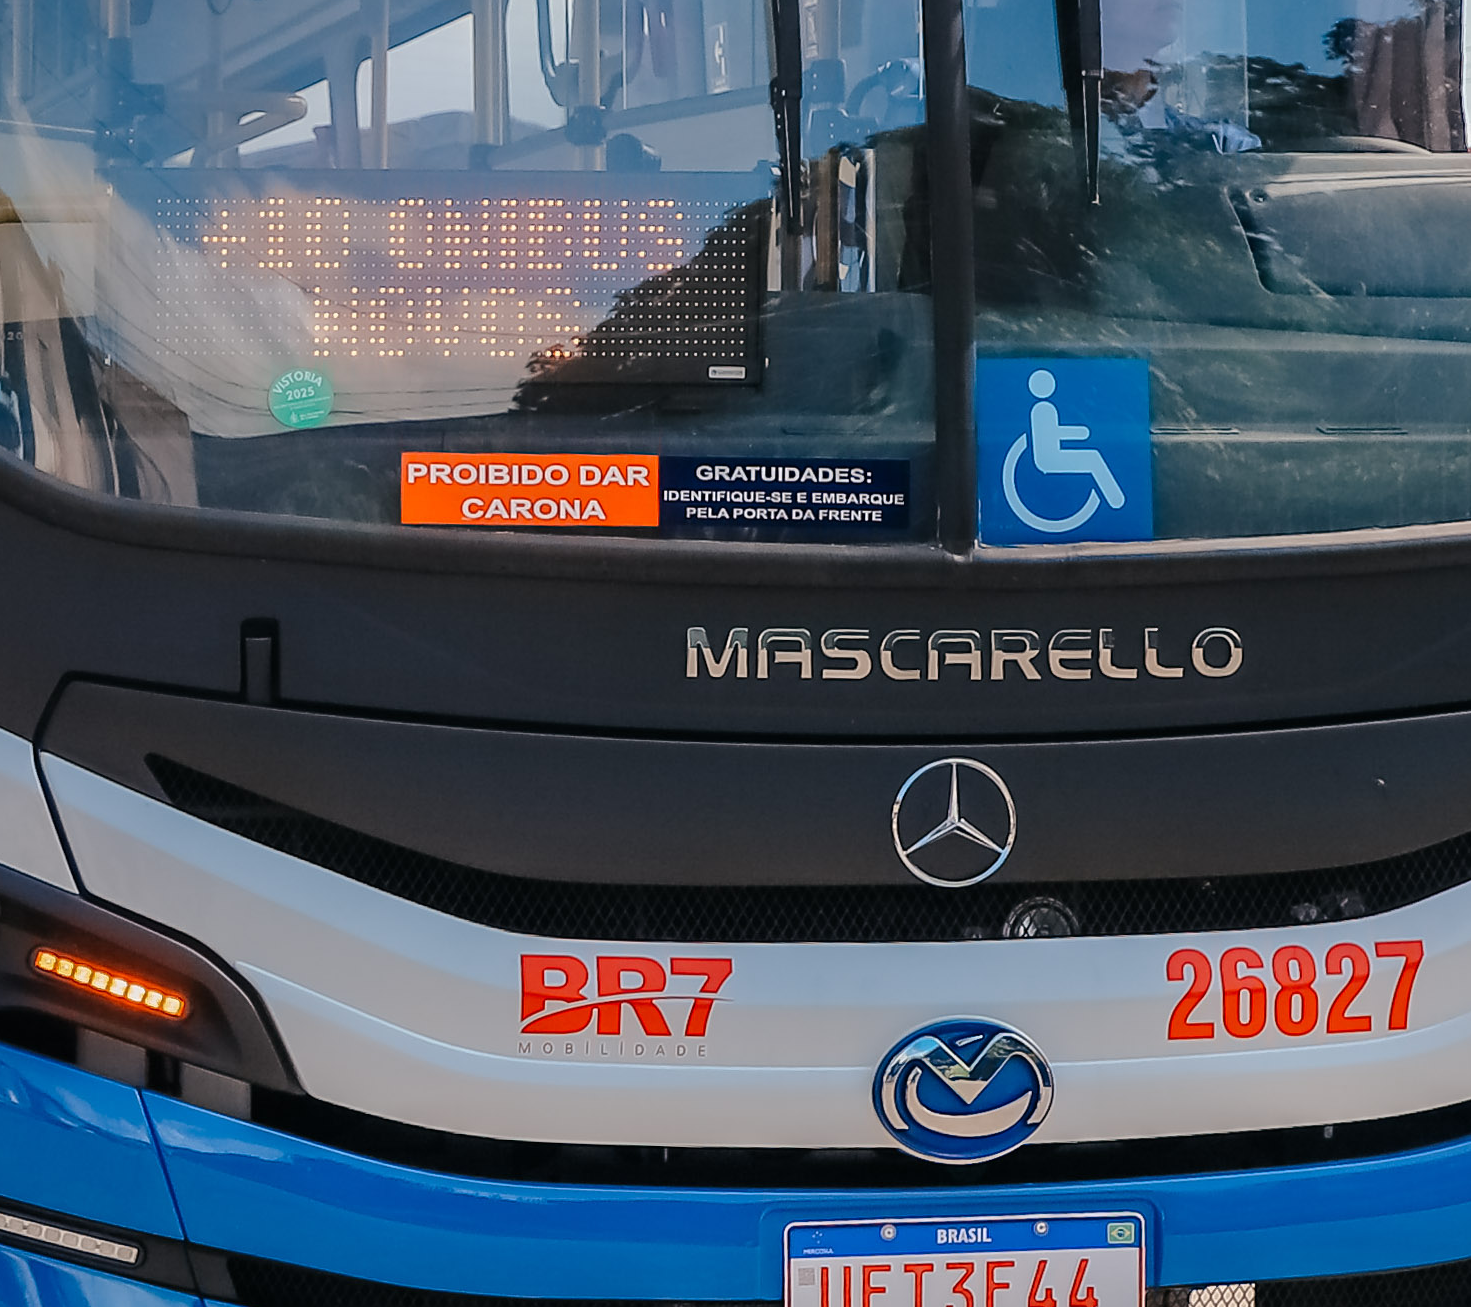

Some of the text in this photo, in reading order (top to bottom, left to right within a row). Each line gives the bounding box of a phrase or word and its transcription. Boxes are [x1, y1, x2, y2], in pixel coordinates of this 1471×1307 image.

[272, 370, 323, 394] VISTORIA
[286, 386, 315, 401] 2025
[407, 463, 651, 486] PROIBIDO DAR
[695, 464, 873, 484] GRATUIDADES:
[461, 497, 607, 521] CARONA
[663, 490, 905, 506] IDENTIFIQUE-SE E EMBARQUE
[686, 507, 883, 522] PELA PORTA DA FRENTE
[685, 626, 1245, 681] MASCARELLO
[520, 954, 734, 1037] BR7
[1165, 939, 1425, 1041] 26827
[936, 1228, 992, 1245] BRASIL
